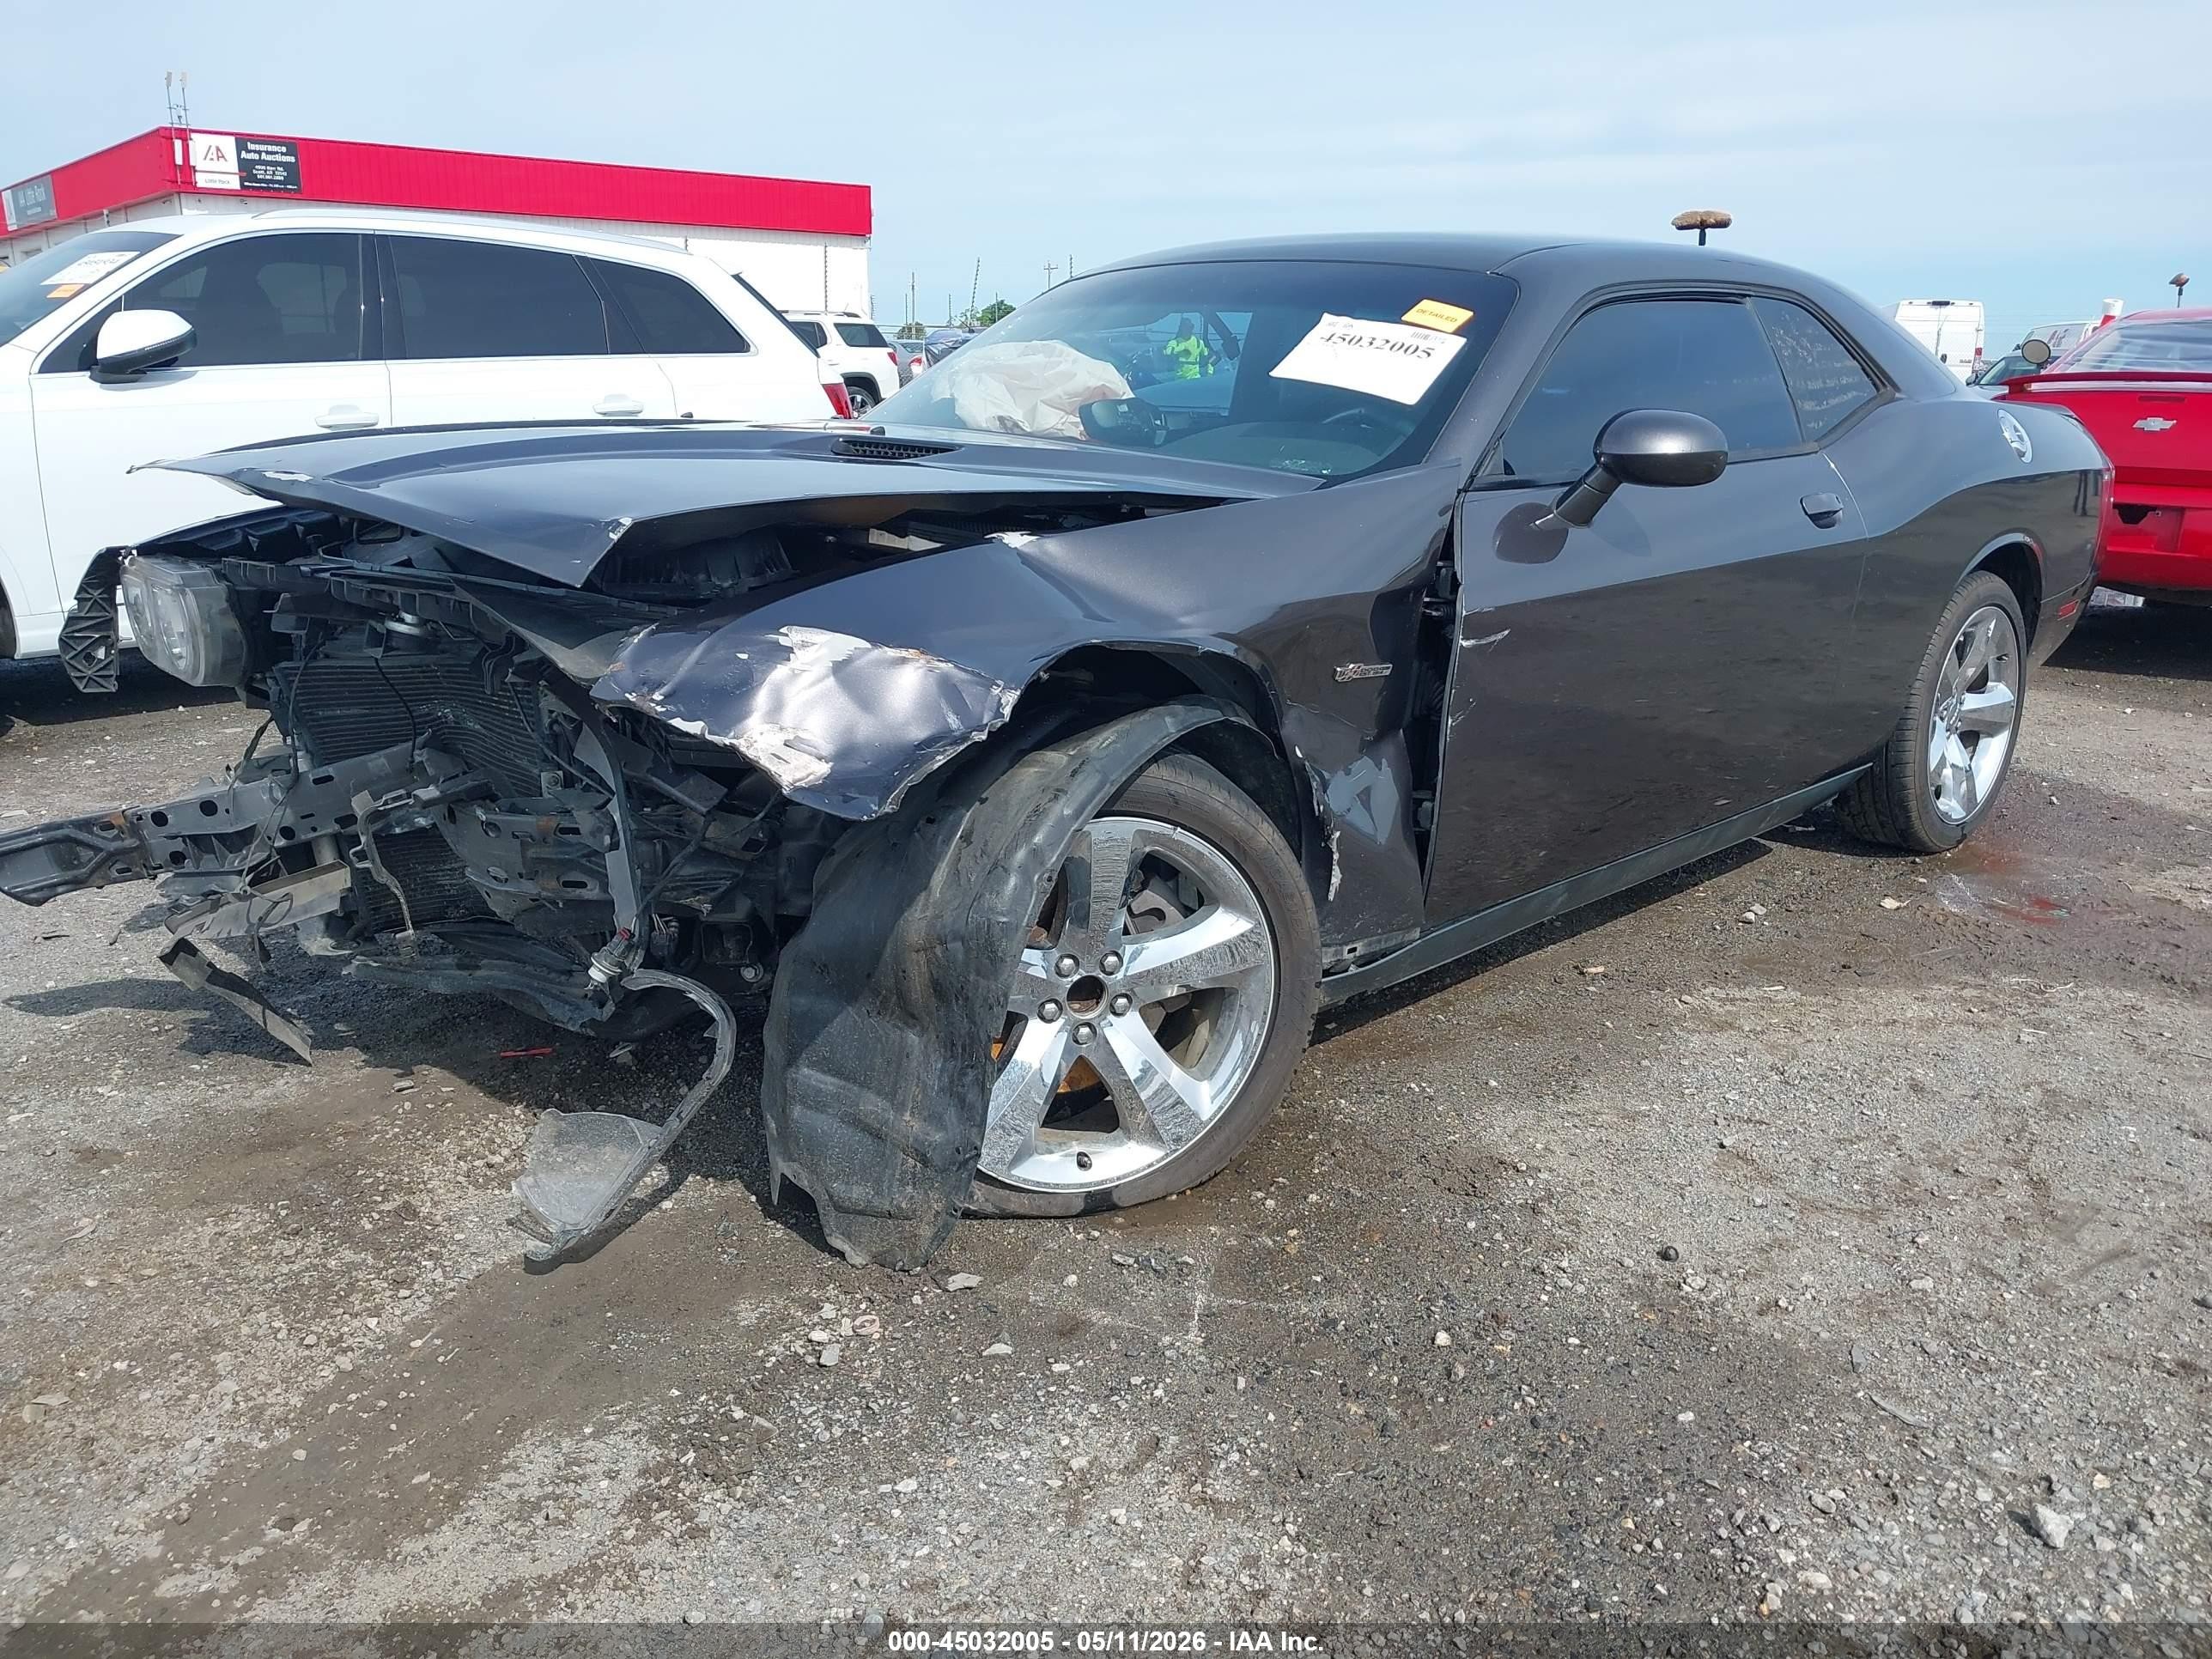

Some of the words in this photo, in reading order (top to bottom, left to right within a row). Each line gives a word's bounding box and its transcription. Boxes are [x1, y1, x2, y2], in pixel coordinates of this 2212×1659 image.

[246, 142, 287, 152] Insurance
[240, 150, 259, 160] Auto
[261, 153, 296, 162] Auctions
[1416, 308, 1458, 323] DETAILED
[1320, 332, 1435, 359] 45032005
